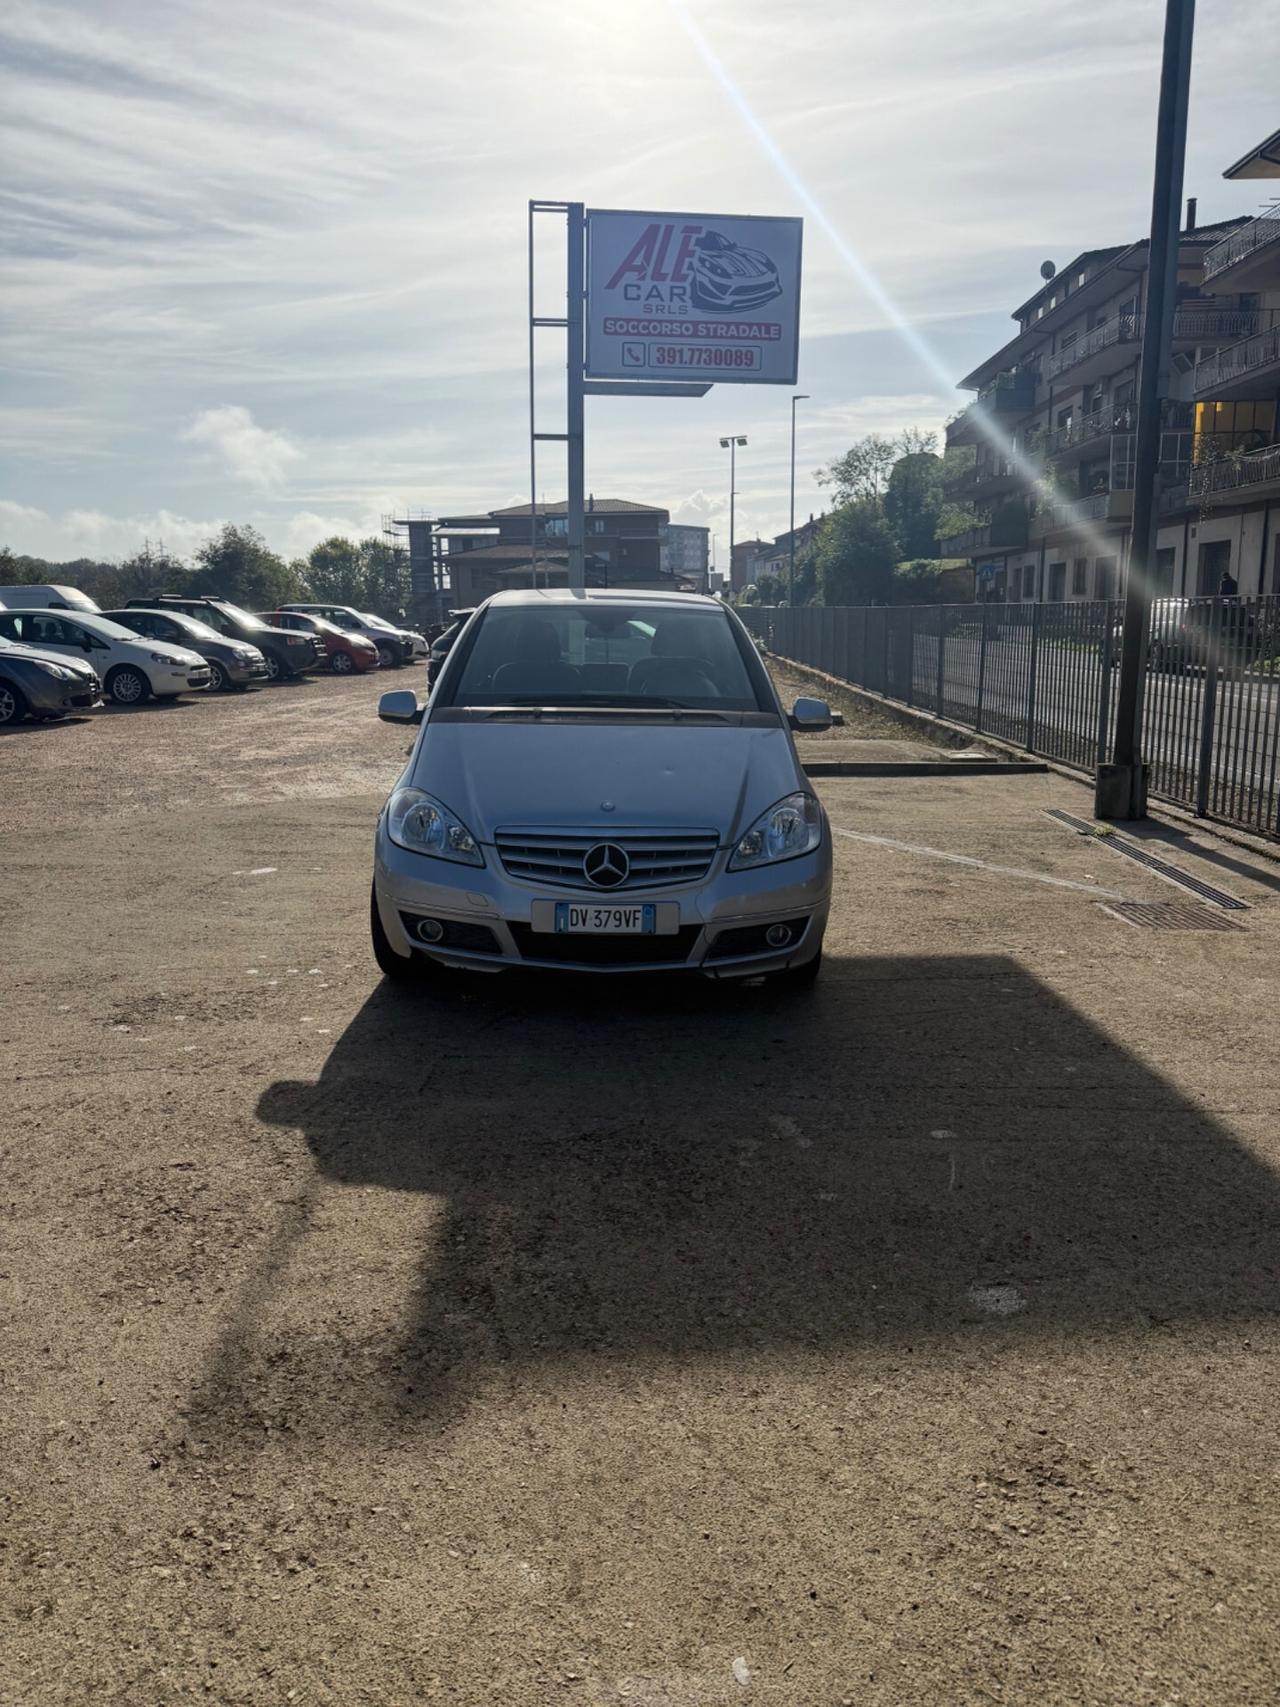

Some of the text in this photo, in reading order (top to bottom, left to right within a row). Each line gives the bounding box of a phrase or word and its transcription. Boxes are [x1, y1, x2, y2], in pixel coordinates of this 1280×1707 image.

[624, 283, 687, 303] CAR
[643, 303, 689, 315] SRLS
[605, 320, 780, 338] SOCCORSO STRADALE
[656, 346, 754, 367] 391.7730089
[570, 908, 641, 928] DV 379VF
